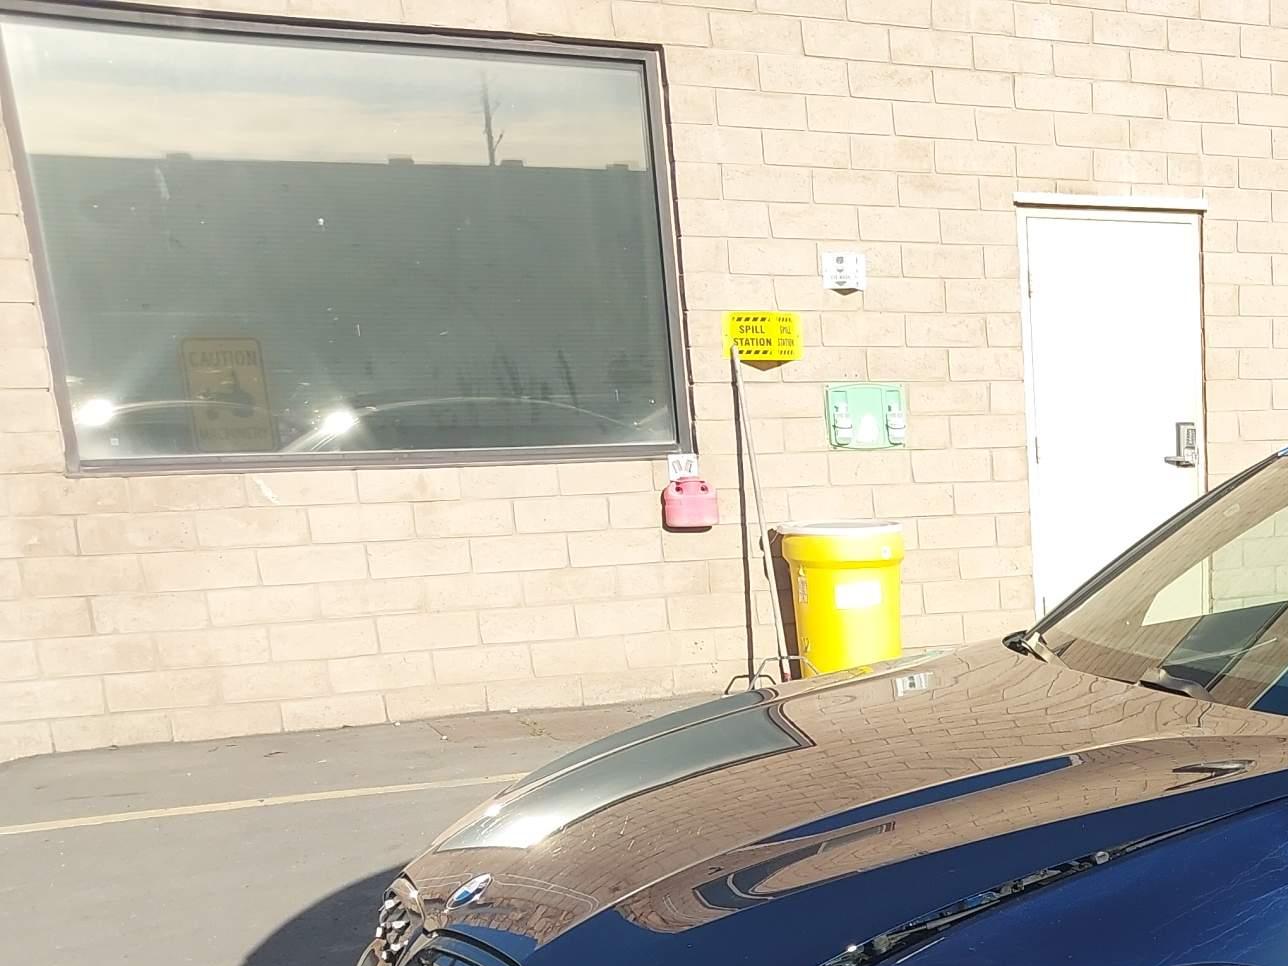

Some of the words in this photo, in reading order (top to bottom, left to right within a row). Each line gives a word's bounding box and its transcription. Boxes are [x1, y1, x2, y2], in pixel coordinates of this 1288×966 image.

[739, 325, 765, 334] SPILL
[733, 337, 772, 346] STATION
[188, 350, 257, 368] CAUTION
